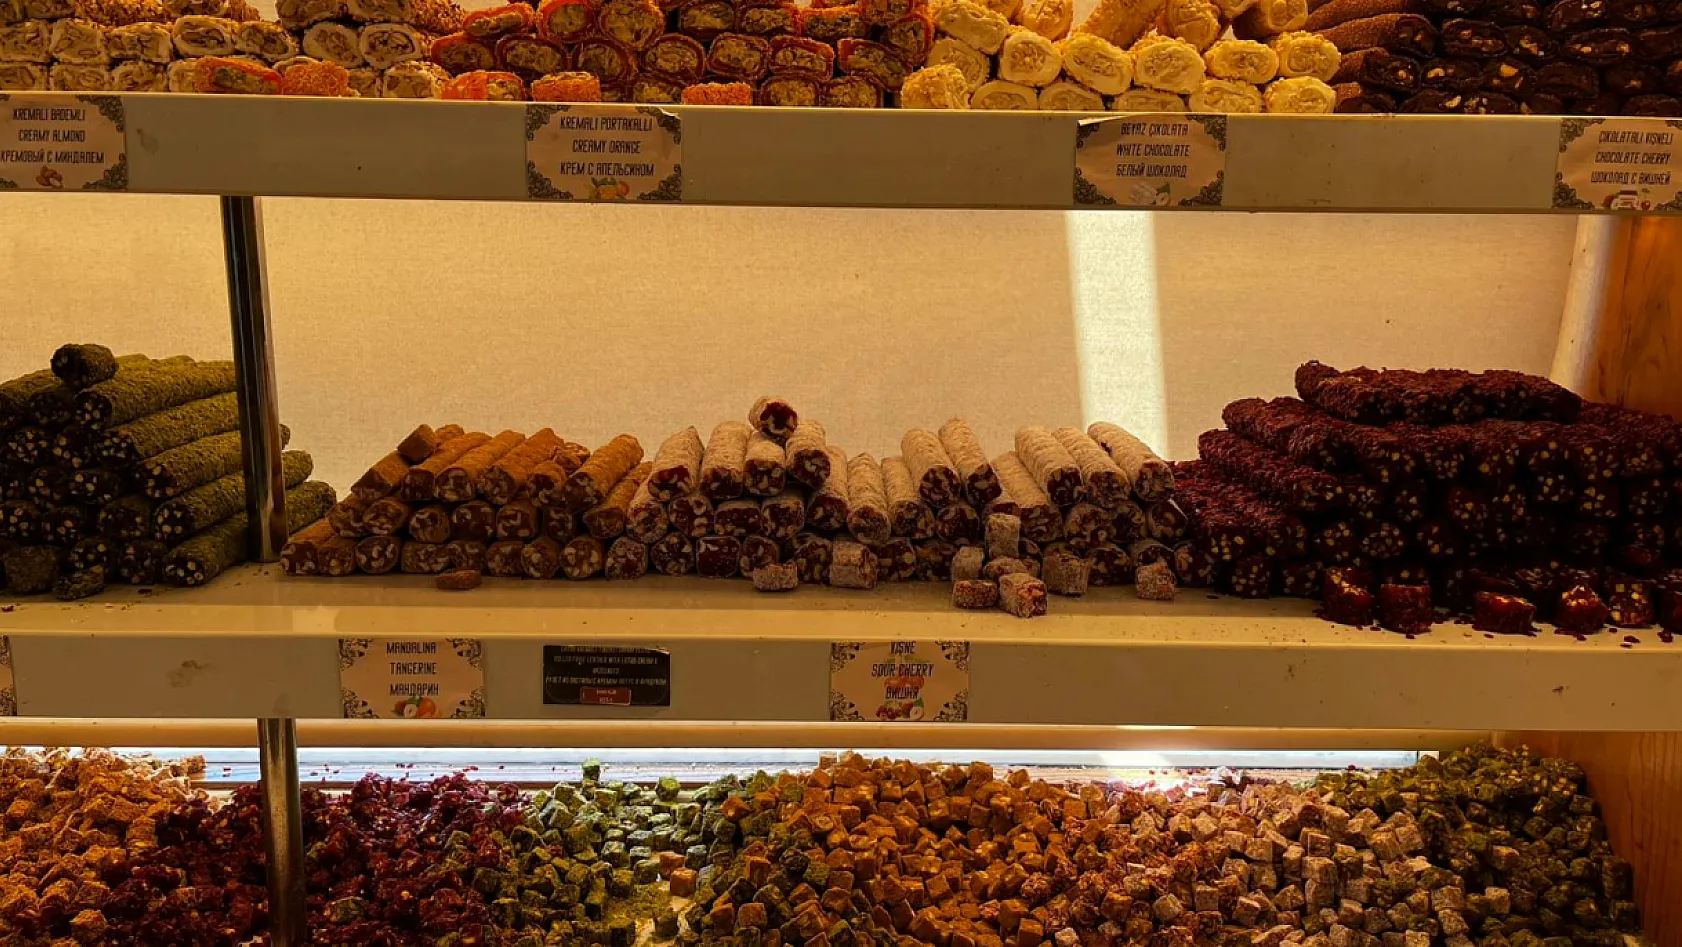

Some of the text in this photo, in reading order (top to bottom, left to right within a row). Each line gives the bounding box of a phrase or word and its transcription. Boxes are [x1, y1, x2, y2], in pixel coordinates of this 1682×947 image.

[560, 116, 653, 131] KREMALI PORTAKALLI
[1121, 122, 1146, 135] BEYAZ
[19, 129, 86, 142] CREAMY ALMOND
[572, 139, 641, 154] CREAMY ORANGE
[1116, 143, 1190, 157] WHITE CHOCOLATE
[1, 149, 45, 163] КРЕМОВЫЙ
[56, 151, 105, 164] МИНДАЛЕМ
[1594, 151, 1672, 165] CHOCOLATE CHERRY
[560, 162, 654, 177] КРЕМ С АПЕЛЬСИНОМ
[1116, 163, 1187, 178] БЕЛЫЙ ШОКОЛАД
[1591, 171, 1630, 185] ШОКОЛАД
[1639, 171, 1671, 185] ВИШНЕЙ
[386, 641, 436, 654] MANDALINA
[389, 662, 437, 675] TANGERINE
[871, 663, 934, 677] SOUR CHERRY
[389, 683, 439, 697] МАНДАРИН
[885, 686, 919, 699] ВИШНЯ
